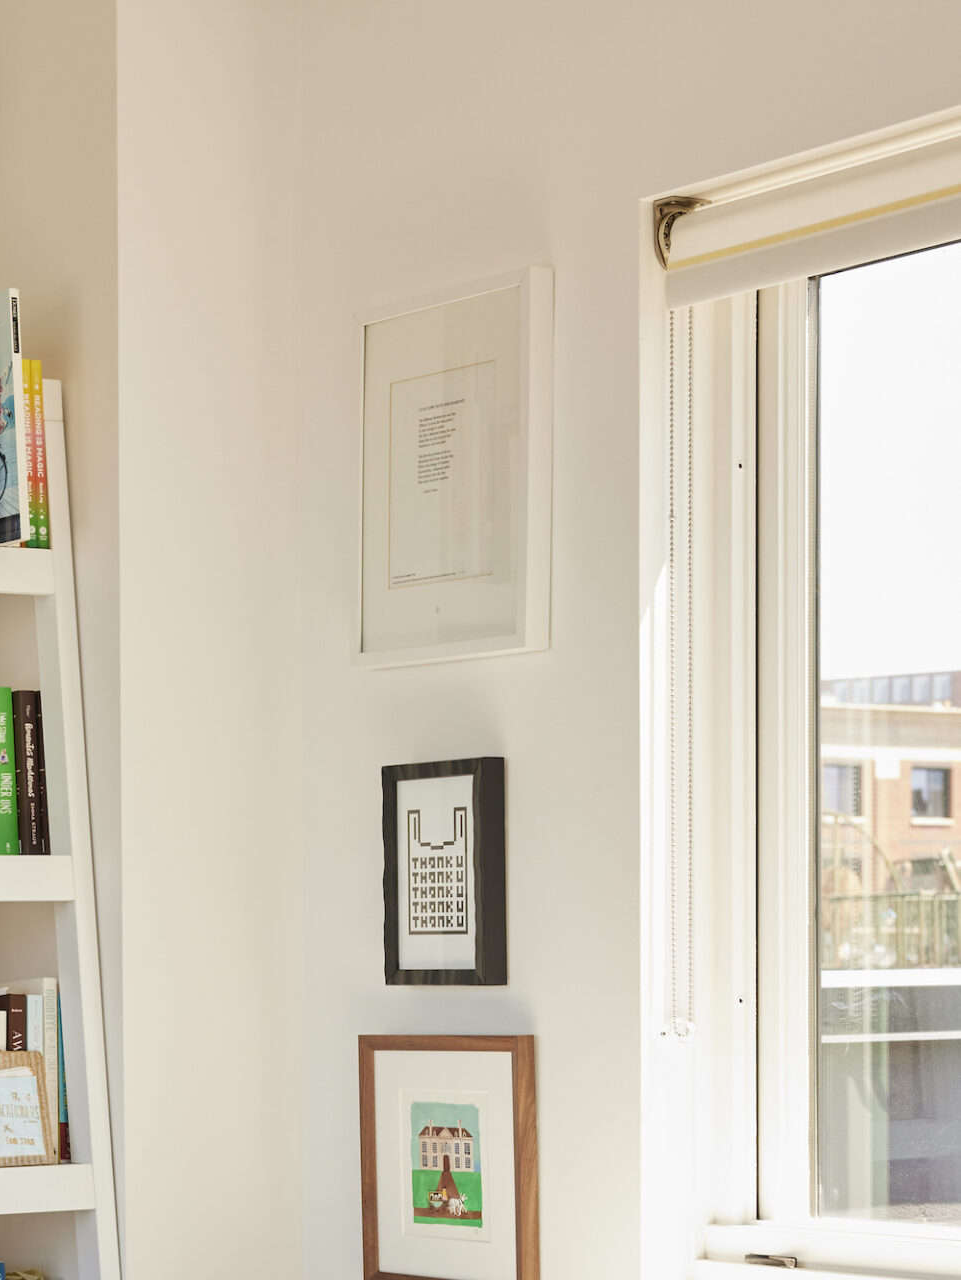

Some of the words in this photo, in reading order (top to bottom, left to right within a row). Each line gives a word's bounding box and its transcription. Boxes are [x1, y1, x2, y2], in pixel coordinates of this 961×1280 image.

[0, 773, 13, 796] UNDER
[0, 800, 13, 815] UNS
[412, 856, 453, 869] THANK
[456, 856, 464, 867] U
[412, 871, 453, 884] THANK
[456, 871, 464, 883] U
[412, 886, 453, 899] THANK
[456, 886, 464, 898] U
[412, 901, 453, 913] THANK
[456, 901, 464, 912] U
[412, 915, 453, 928] THANK
[456, 915, 464, 928] U
